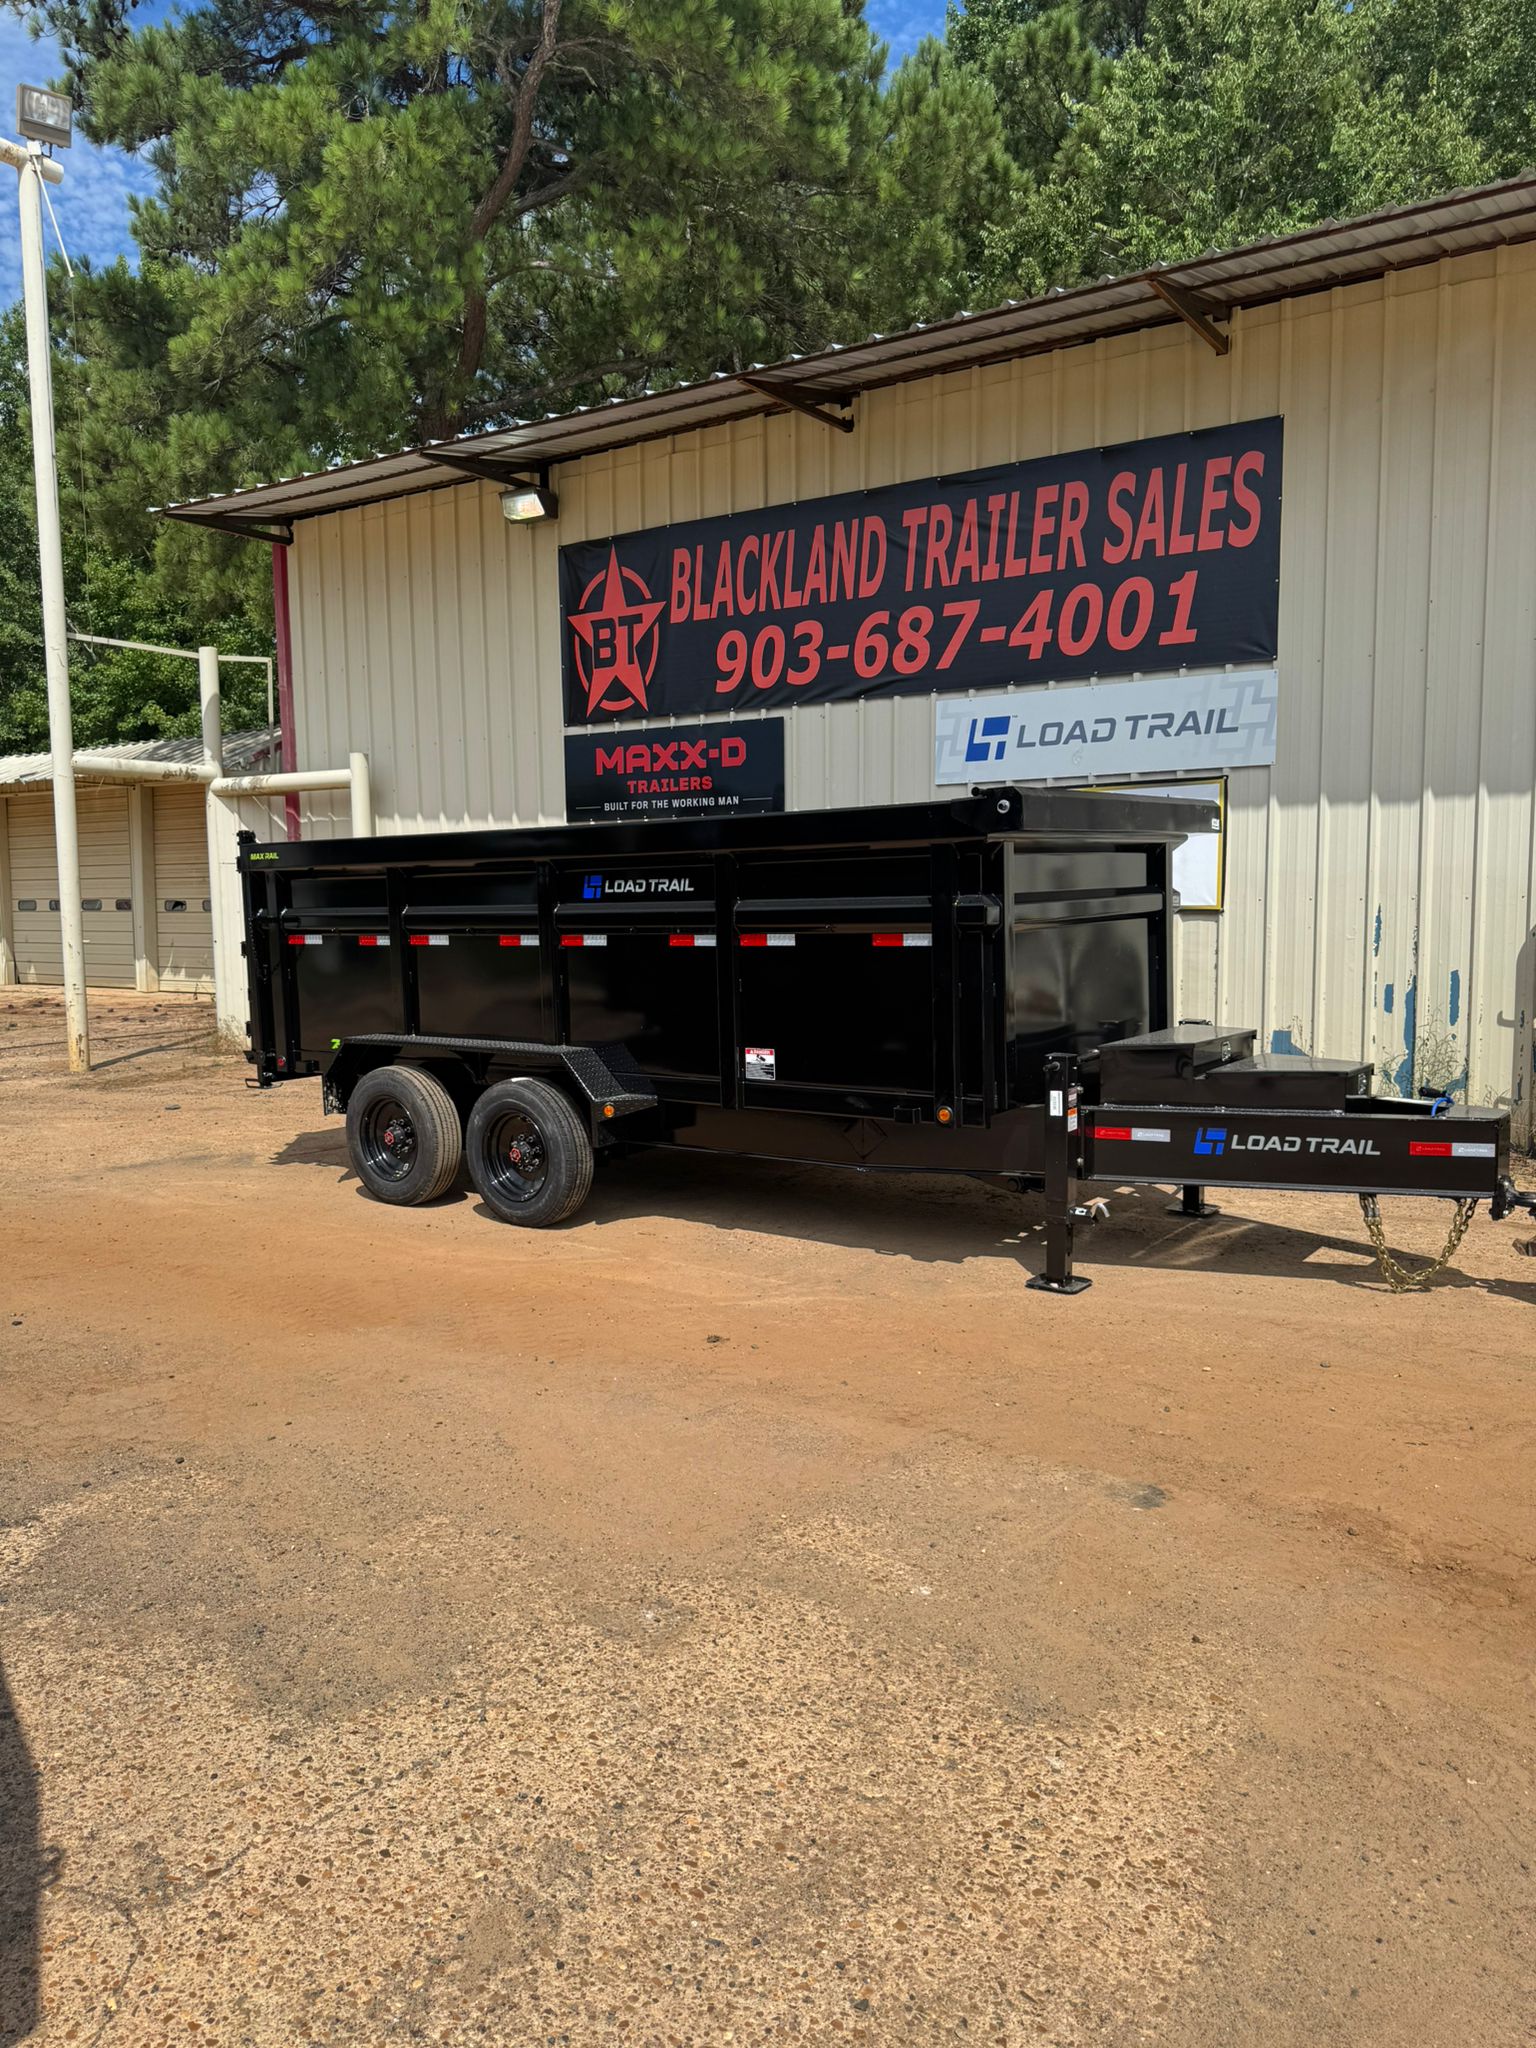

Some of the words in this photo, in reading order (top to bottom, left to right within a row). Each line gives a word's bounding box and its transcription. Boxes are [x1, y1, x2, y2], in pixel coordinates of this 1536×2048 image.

[670, 515, 888, 624] BLACKLAND
[902, 481, 1090, 592] TRAILER
[1102, 450, 1265, 564] SALES
[590, 613, 643, 669] BT
[715, 570, 1198, 693] 903-687-4001
[1016, 717, 1117, 748] LOAD
[1125, 708, 1239, 740] TRAIL
[595, 736, 747, 776] MAXX-D
[627, 776, 713, 794] TRAILERS
[604, 801, 628, 812] BUILT
[631, 800, 648, 810] FOR
[652, 799, 669, 809] THE
[672, 797, 715, 808] WORKING
[718, 796, 739, 806] MAN
[250, 852, 264, 860] MAX
[605, 879, 646, 893] LOAD
[648, 878, 694, 892] TRAIL
[1231, 1134, 1301, 1151] LOAD
[1306, 1137, 1381, 1156] TRAIL
